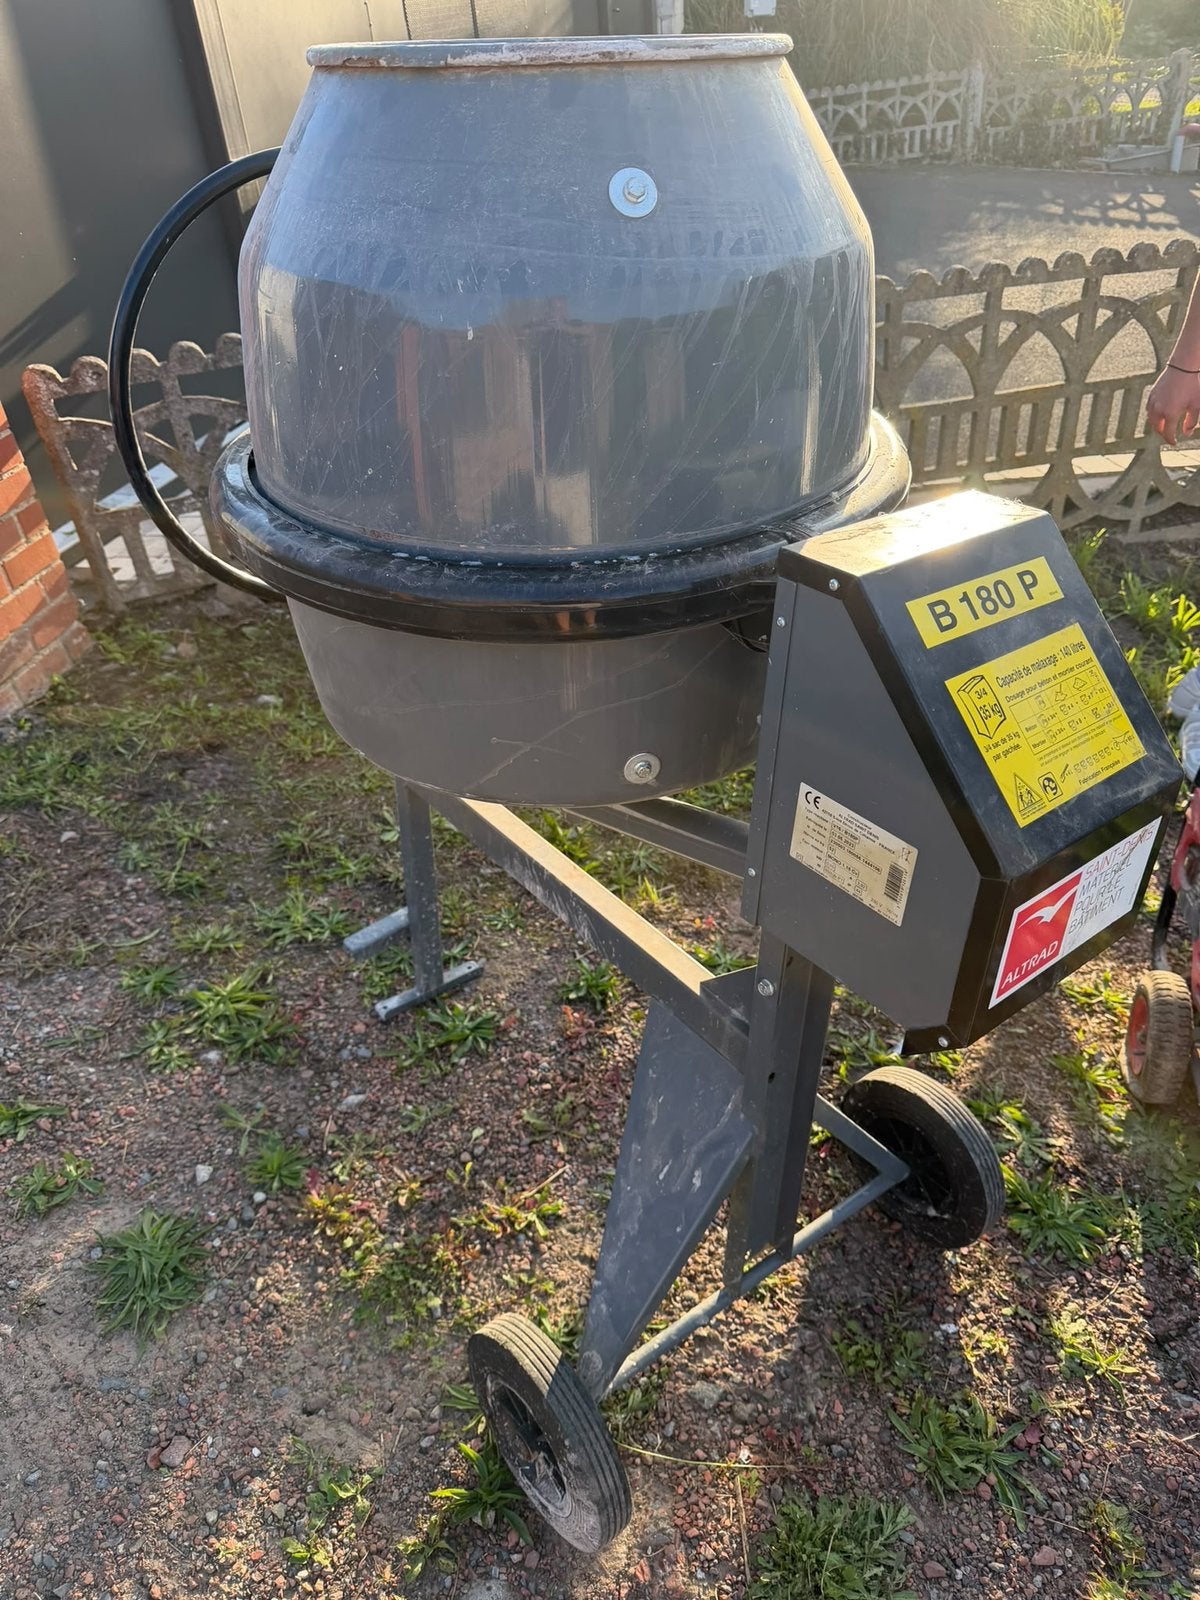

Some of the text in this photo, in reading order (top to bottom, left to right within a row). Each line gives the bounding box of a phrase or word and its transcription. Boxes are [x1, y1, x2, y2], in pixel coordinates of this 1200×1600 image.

[927, 569, 1038, 633] B 180 P
[996, 667, 1023, 687] Capacité
[1022, 665, 1032, 676] de
[1030, 654, 1058, 671] malaxage
[1059, 645, 1071, 658] 140
[1069, 641, 1085, 653] litres
[1005, 690, 1025, 702] Dosage
[1025, 684, 1037, 694] pour
[1037, 677, 1052, 687] béton
[1057, 666, 1075, 677] mortier
[1075, 657, 1093, 669] courant
[974, 688, 987, 699] 3/4
[979, 703, 1002, 720] 35 kg
[983, 744, 992, 752] 3/4
[991, 741, 1001, 749] sac
[1006, 733, 1013, 741] 35
[992, 753, 1001, 762] par
[1078, 770, 1101, 784] Fabrication
[1100, 759, 1120, 771] Française
[1001, 941, 1057, 988] ALTRAD
